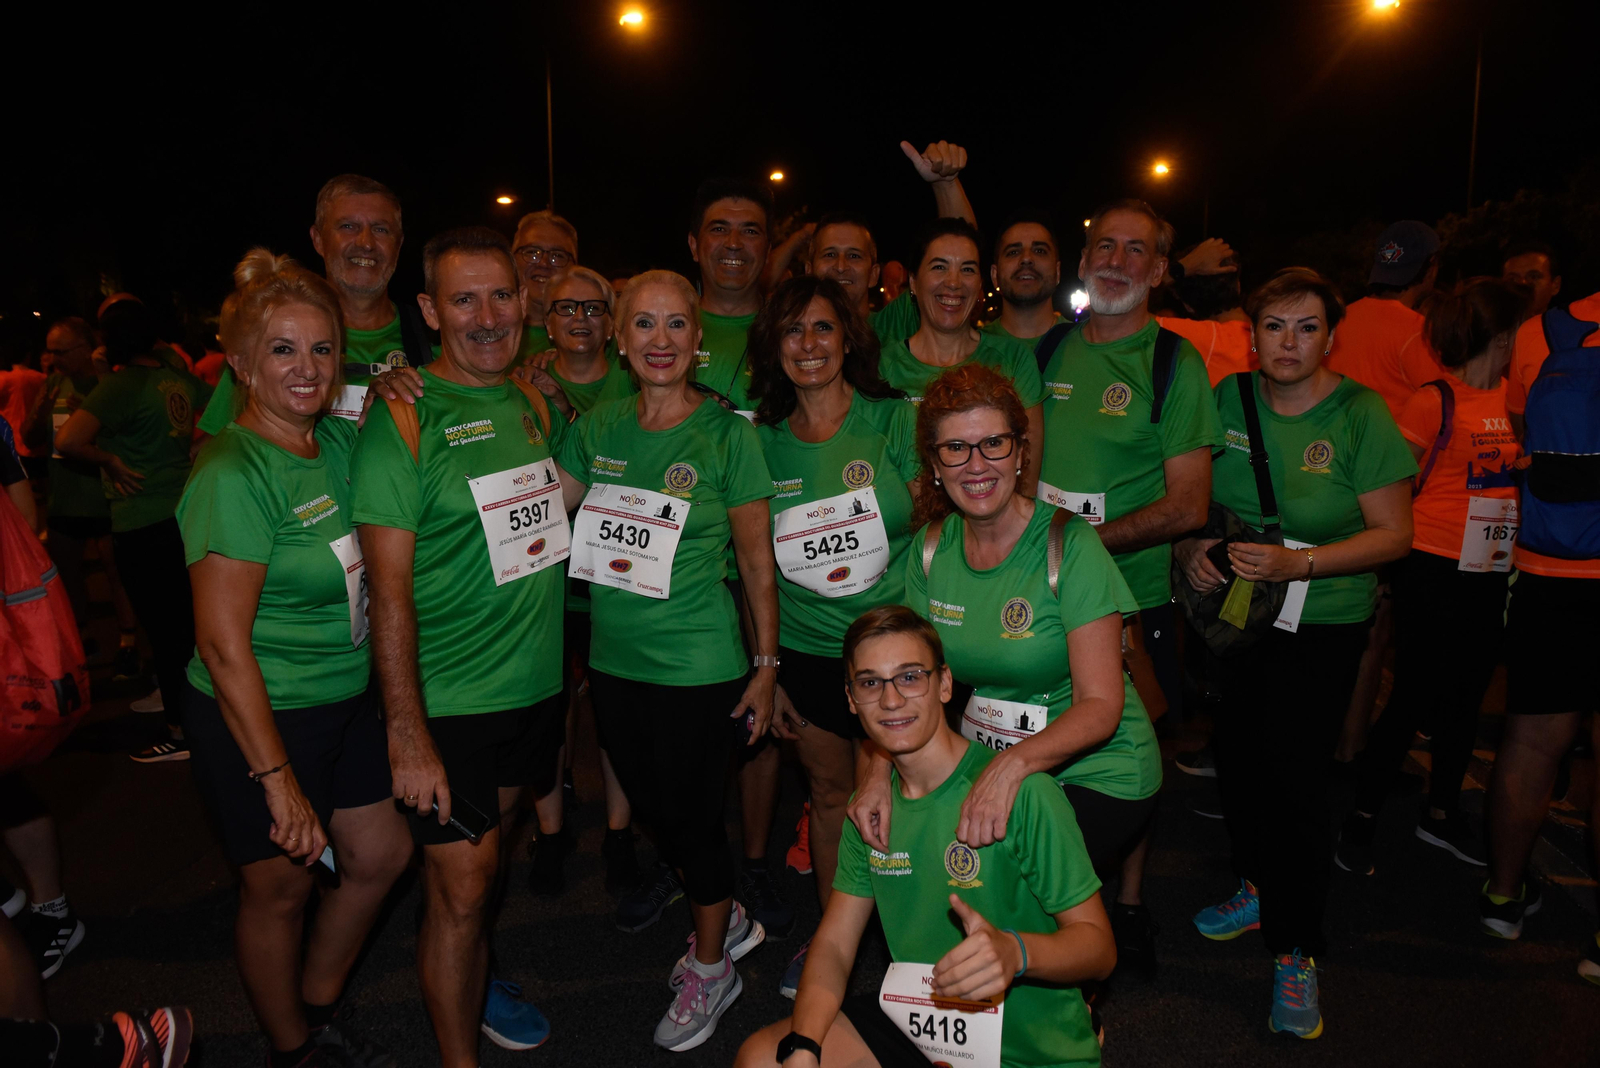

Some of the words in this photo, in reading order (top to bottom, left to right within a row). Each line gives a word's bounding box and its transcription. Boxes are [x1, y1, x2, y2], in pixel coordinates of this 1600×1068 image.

[444, 424, 462, 435] XXXV
[463, 419, 493, 429] CARRERA
[1482, 417, 1509, 431] XXX
[445, 424, 495, 441] NOCTURNA
[460, 432, 496, 445] Guadalquivir
[1478, 438, 1516, 446] GUADALQ
[774, 482, 803, 493] CTURNA
[779, 478, 803, 486] CARRERA
[293, 504, 307, 515] XXXV
[306, 494, 330, 508] CARRERA
[297, 498, 336, 521] NOCTURNA
[509, 499, 550, 532] 5397
[608, 509, 627, 517] NOCTURNA
[633, 515, 659, 525] GUADALQUIVIR
[499, 537, 513, 546] JESÚS
[512, 530, 527, 541] MARÍA
[526, 526, 542, 536] GÓMEZ
[599, 520, 650, 549] 5430
[787, 531, 804, 539] CARRERA
[803, 525, 825, 535] NOCTURNA
[1483, 525, 1519, 541] 1867
[585, 541, 601, 549] MARIA
[601, 544, 617, 552] JESUS
[629, 551, 659, 562] SOTOMAYOR
[803, 530, 859, 560] 5425
[805, 559, 832, 570] MILAGROS
[832, 554, 857, 564] MARQUEZ
[858, 546, 883, 557] ACEVEDO
[637, 582, 663, 593] Cruzcampo
[943, 603, 965, 612] ARRERA
[909, 1012, 967, 1045] 5418
[924, 1044, 944, 1055] MUÑOZ
[944, 1050, 974, 1060] GALLARDO
